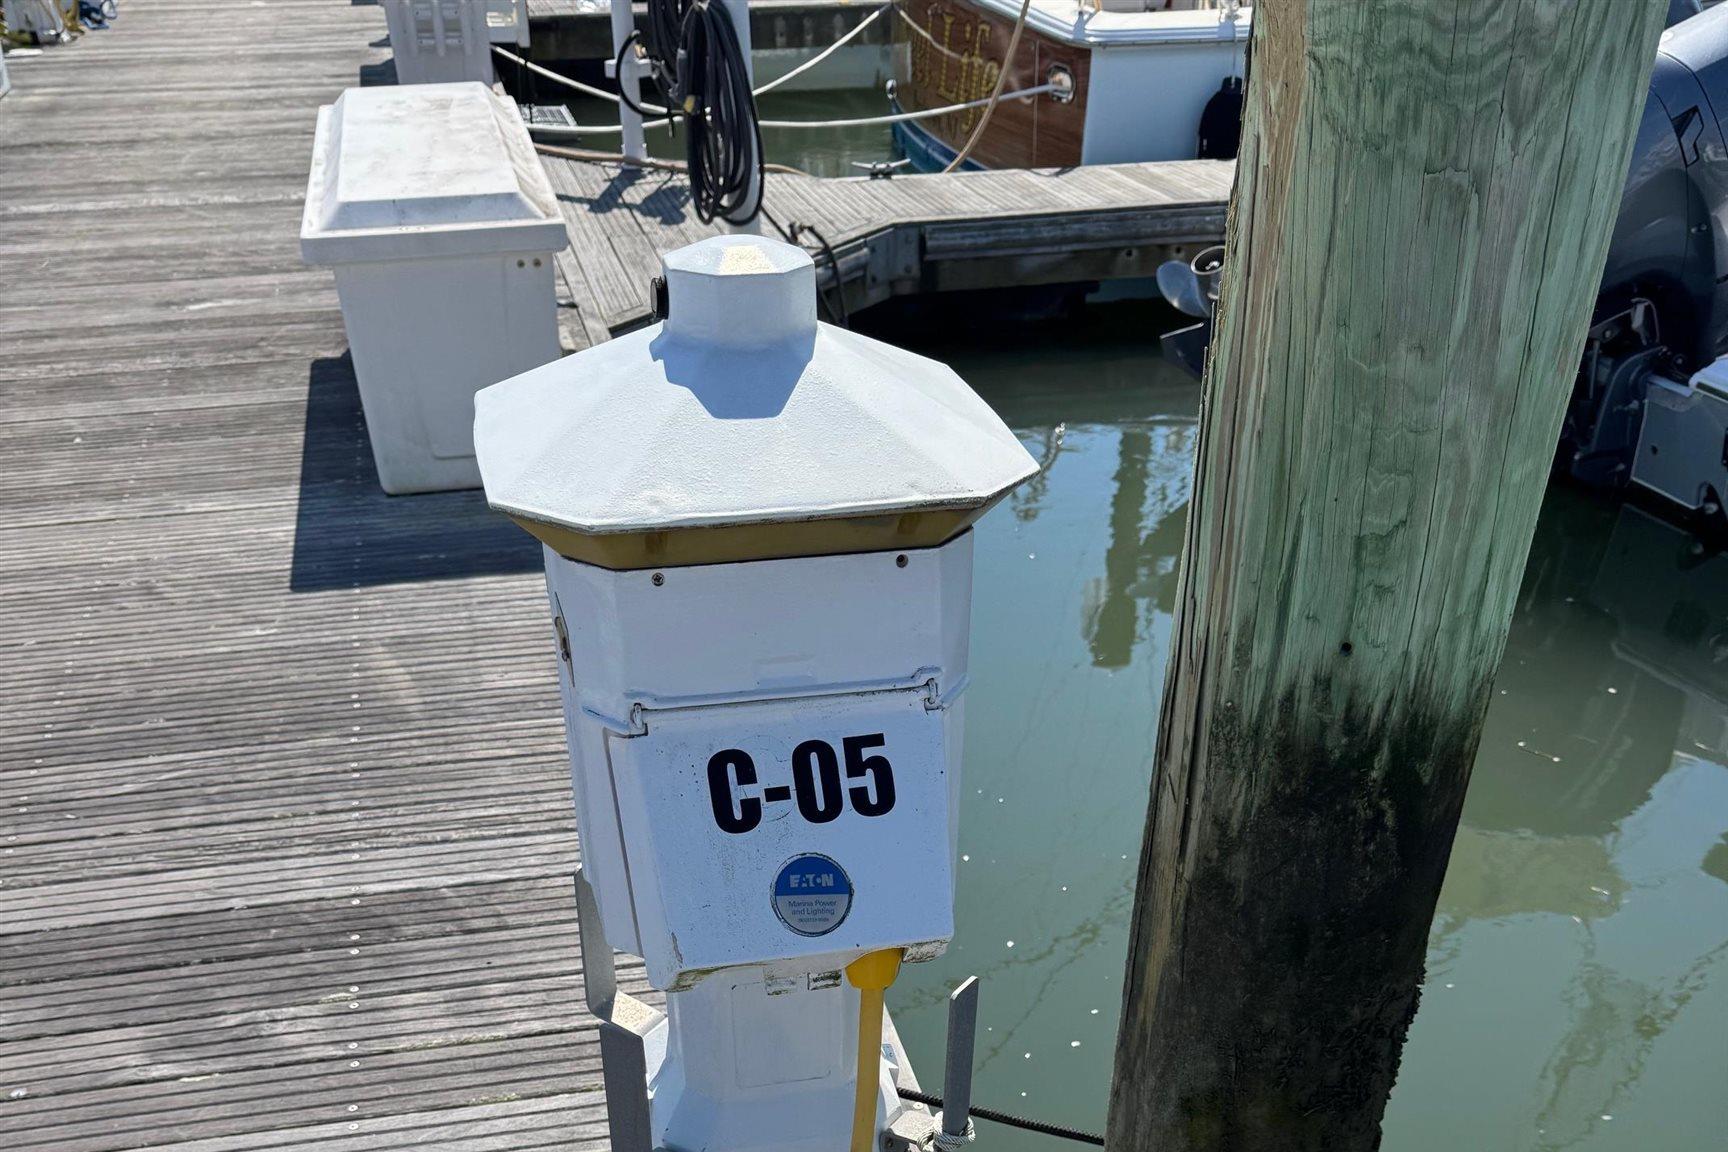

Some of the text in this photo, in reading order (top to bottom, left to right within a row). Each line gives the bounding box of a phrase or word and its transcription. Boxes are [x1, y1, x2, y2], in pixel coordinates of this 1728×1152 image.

[707, 732, 896, 834] C-05
[789, 873, 834, 888] EATON
[815, 899, 837, 907] Power
[806, 907, 835, 916] Lighting
